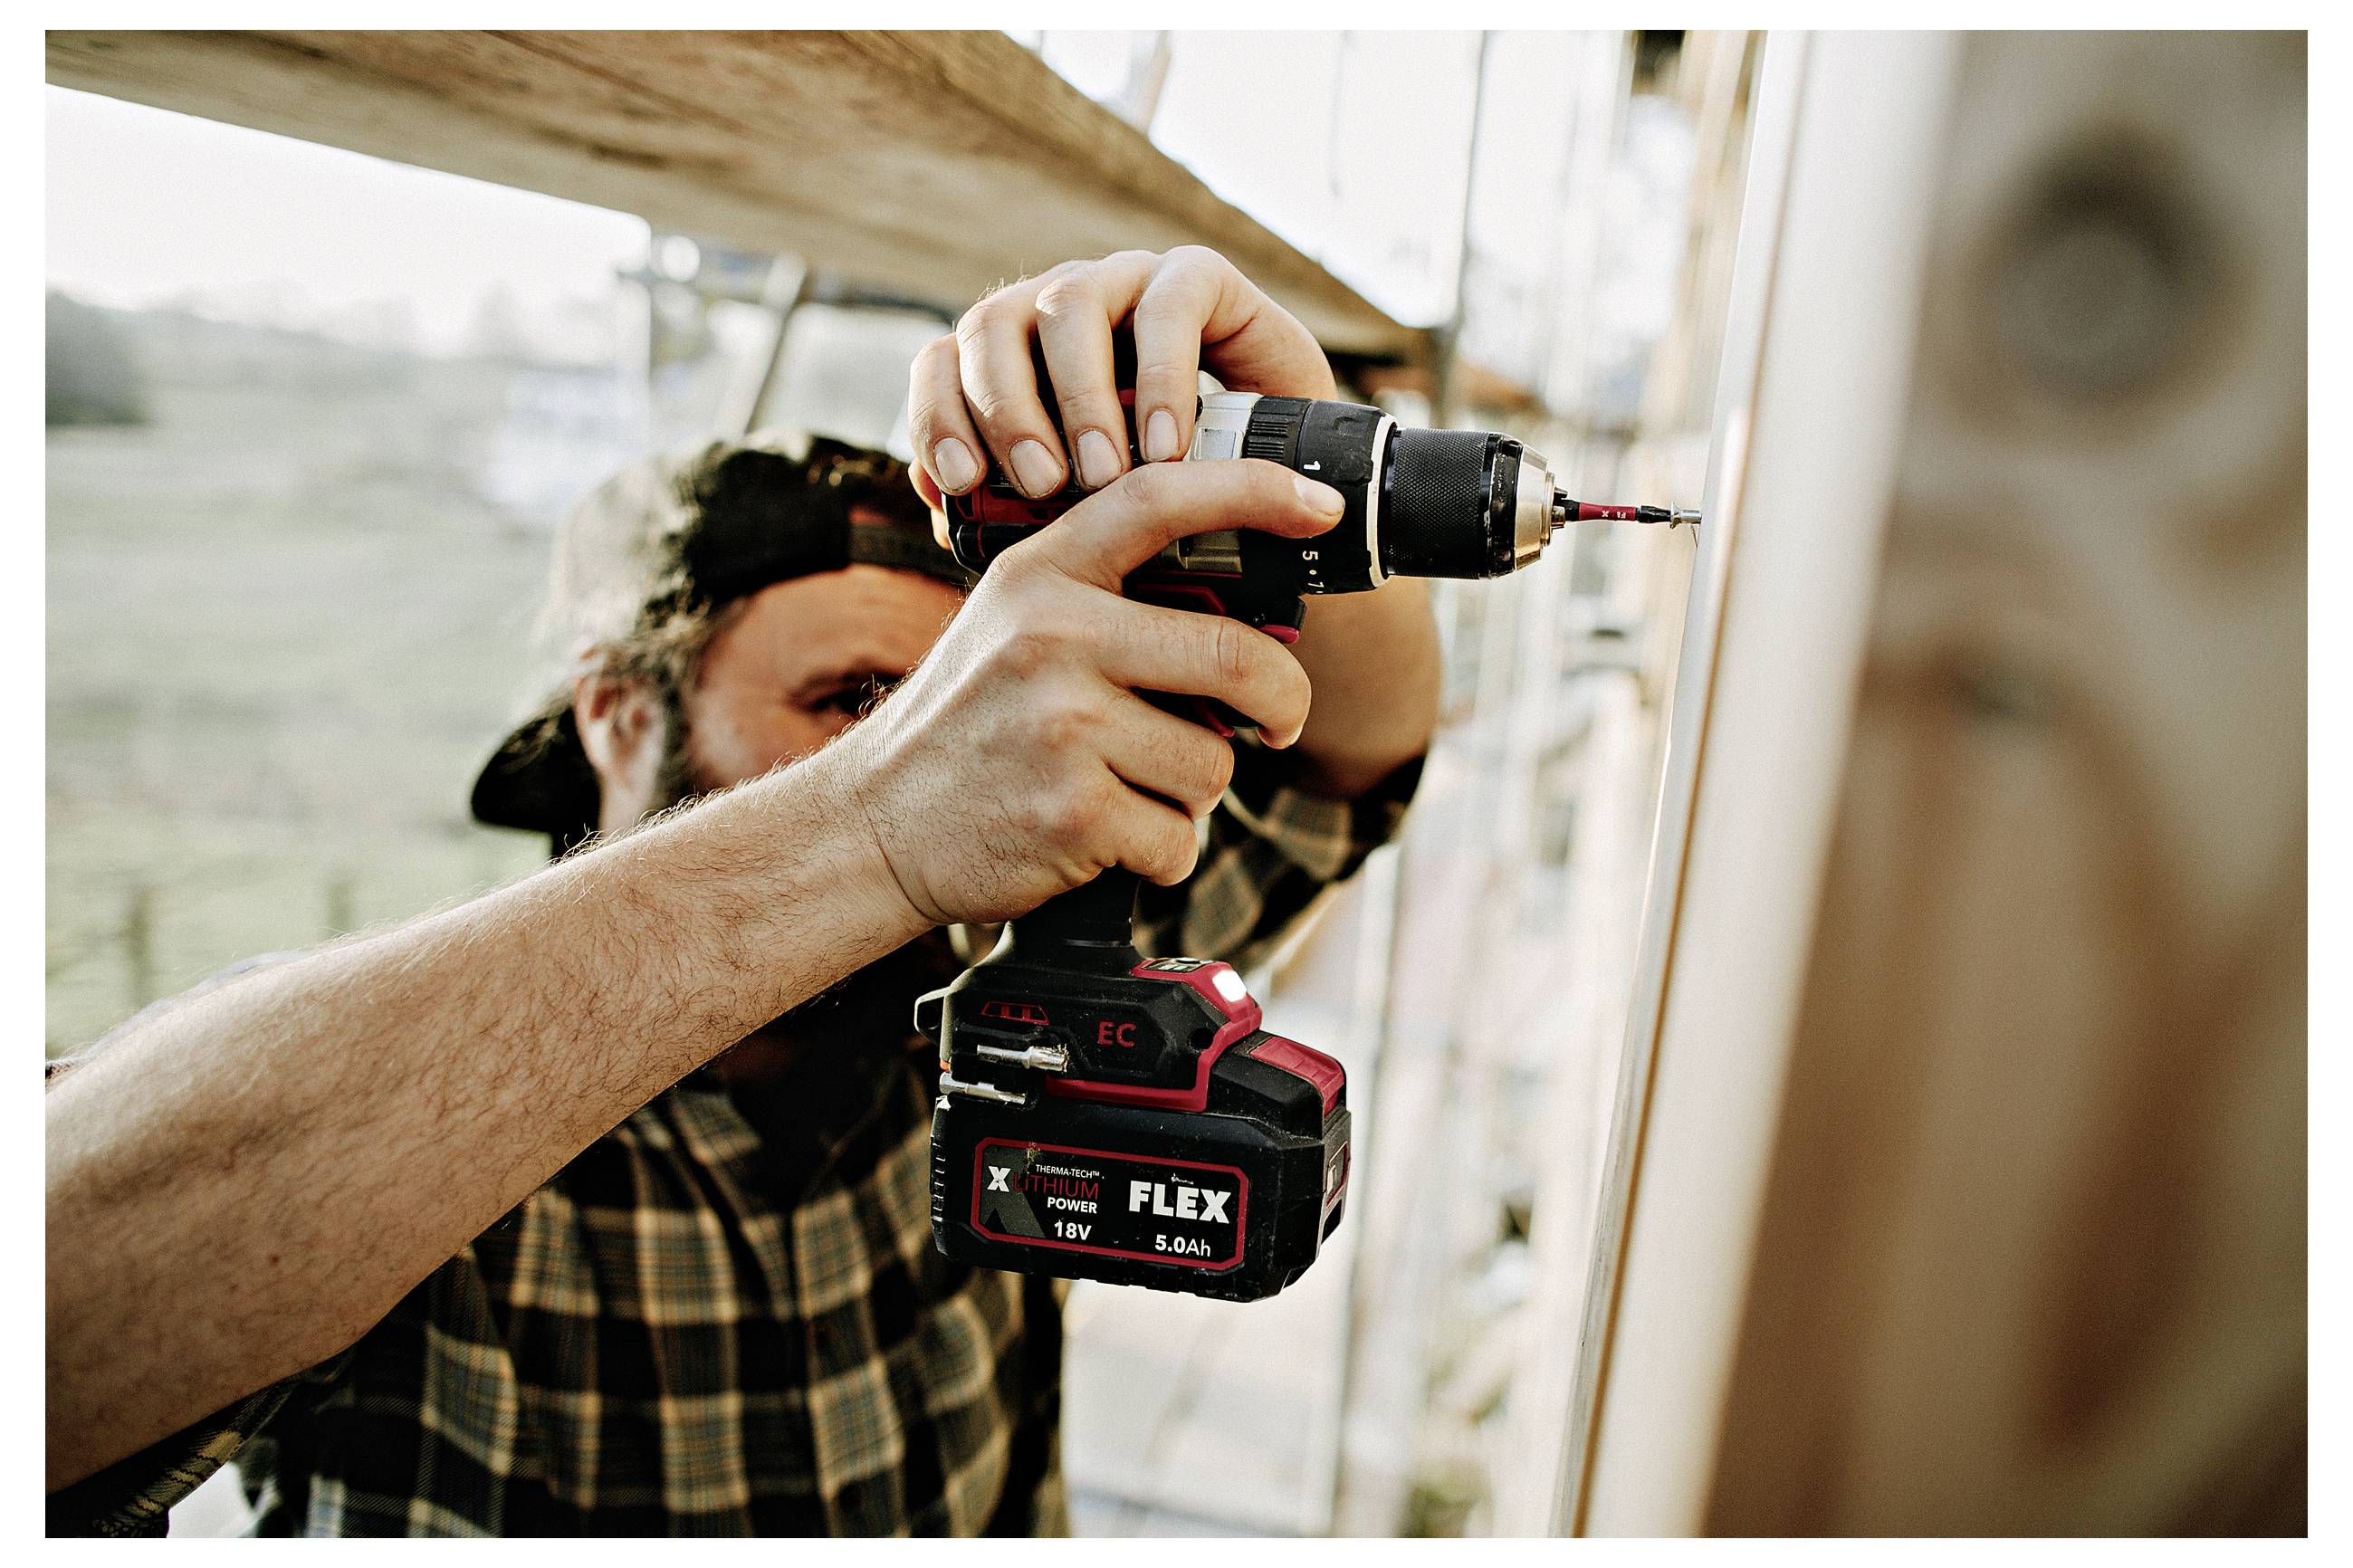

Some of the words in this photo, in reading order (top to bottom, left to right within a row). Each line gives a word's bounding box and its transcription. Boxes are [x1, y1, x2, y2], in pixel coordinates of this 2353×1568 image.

[1304, 460, 1321, 471] 1
[1302, 550, 1318, 560] 5
[1096, 1020, 1137, 1047] EC
[987, 1165, 1011, 1192] X
[1047, 1197, 1097, 1214] POWER
[1129, 1180, 1231, 1224] FLEX
[1055, 1220, 1092, 1240] 18V
[1154, 1234, 1211, 1257] 5.0Ah
